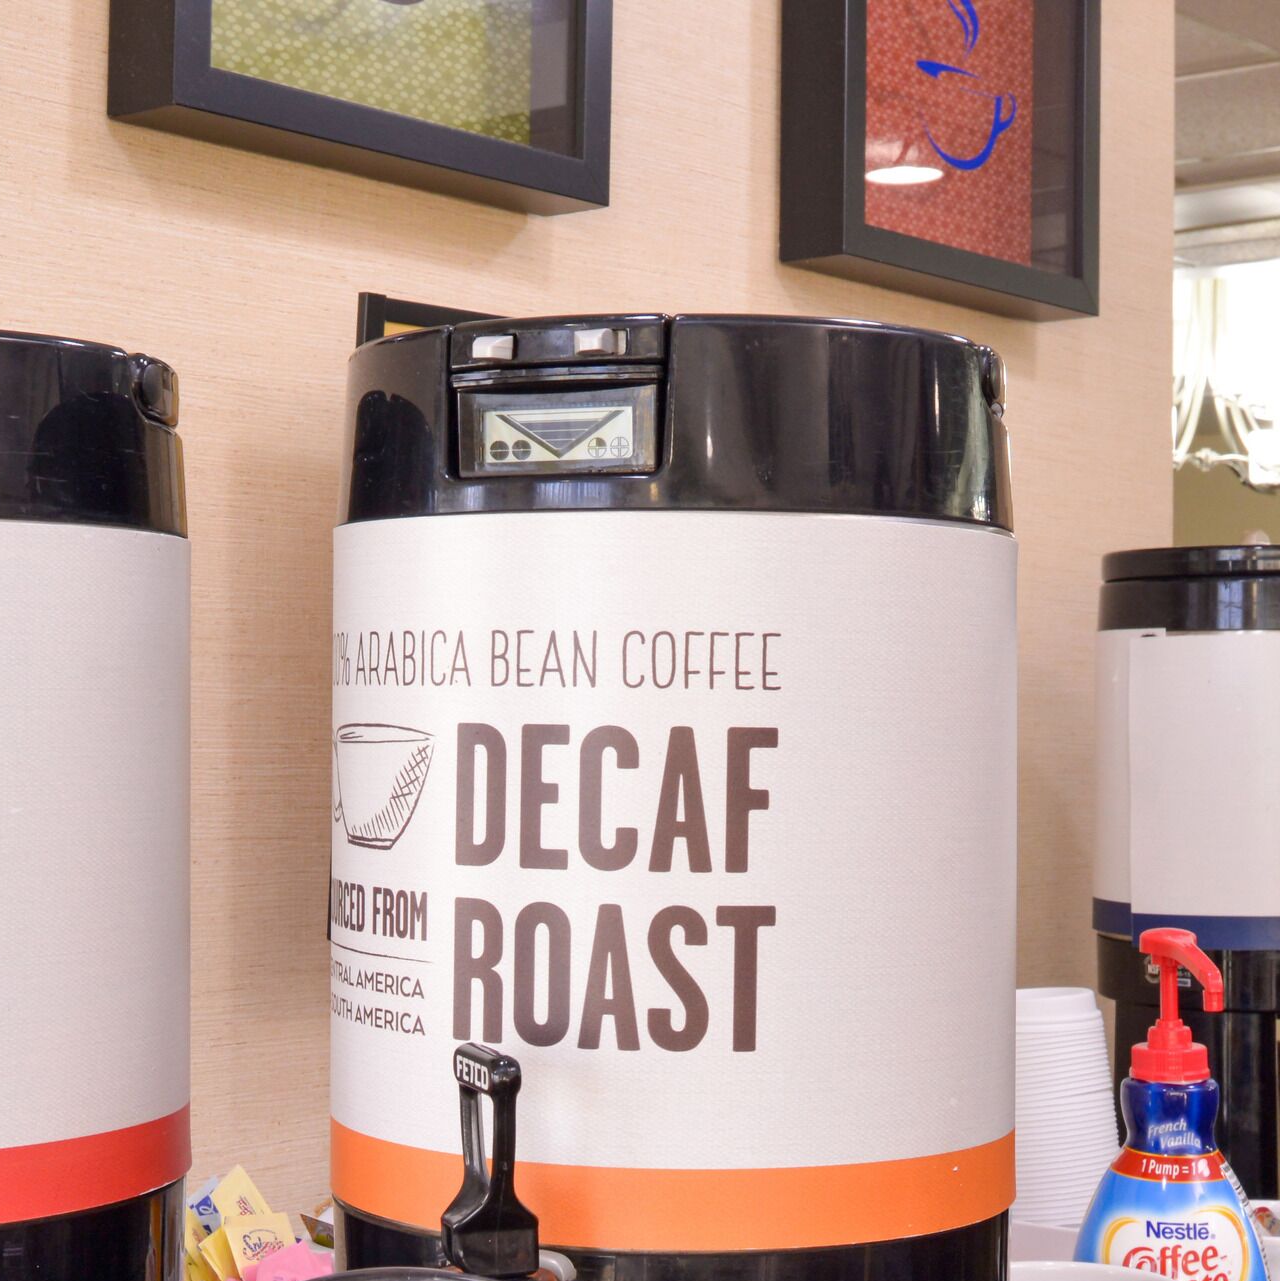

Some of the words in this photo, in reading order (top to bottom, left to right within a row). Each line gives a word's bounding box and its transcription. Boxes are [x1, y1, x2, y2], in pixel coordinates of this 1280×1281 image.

[355, 630, 471, 687] ARABICA
[491, 630, 597, 688] BEAN
[623, 631, 782, 690] COFFEE
[455, 722, 779, 873] DECAF
[372, 886, 428, 941] FROM
[355, 969, 425, 999] AMERICA
[453, 897, 777, 1052] ROAST
[355, 1004, 426, 1036] AMERICA
[456, 1054, 489, 1091] FETCO
[1147, 1118, 1187, 1139] French
[1160, 1131, 1202, 1149] Vanilla
[1148, 1159, 1180, 1179] Pump
